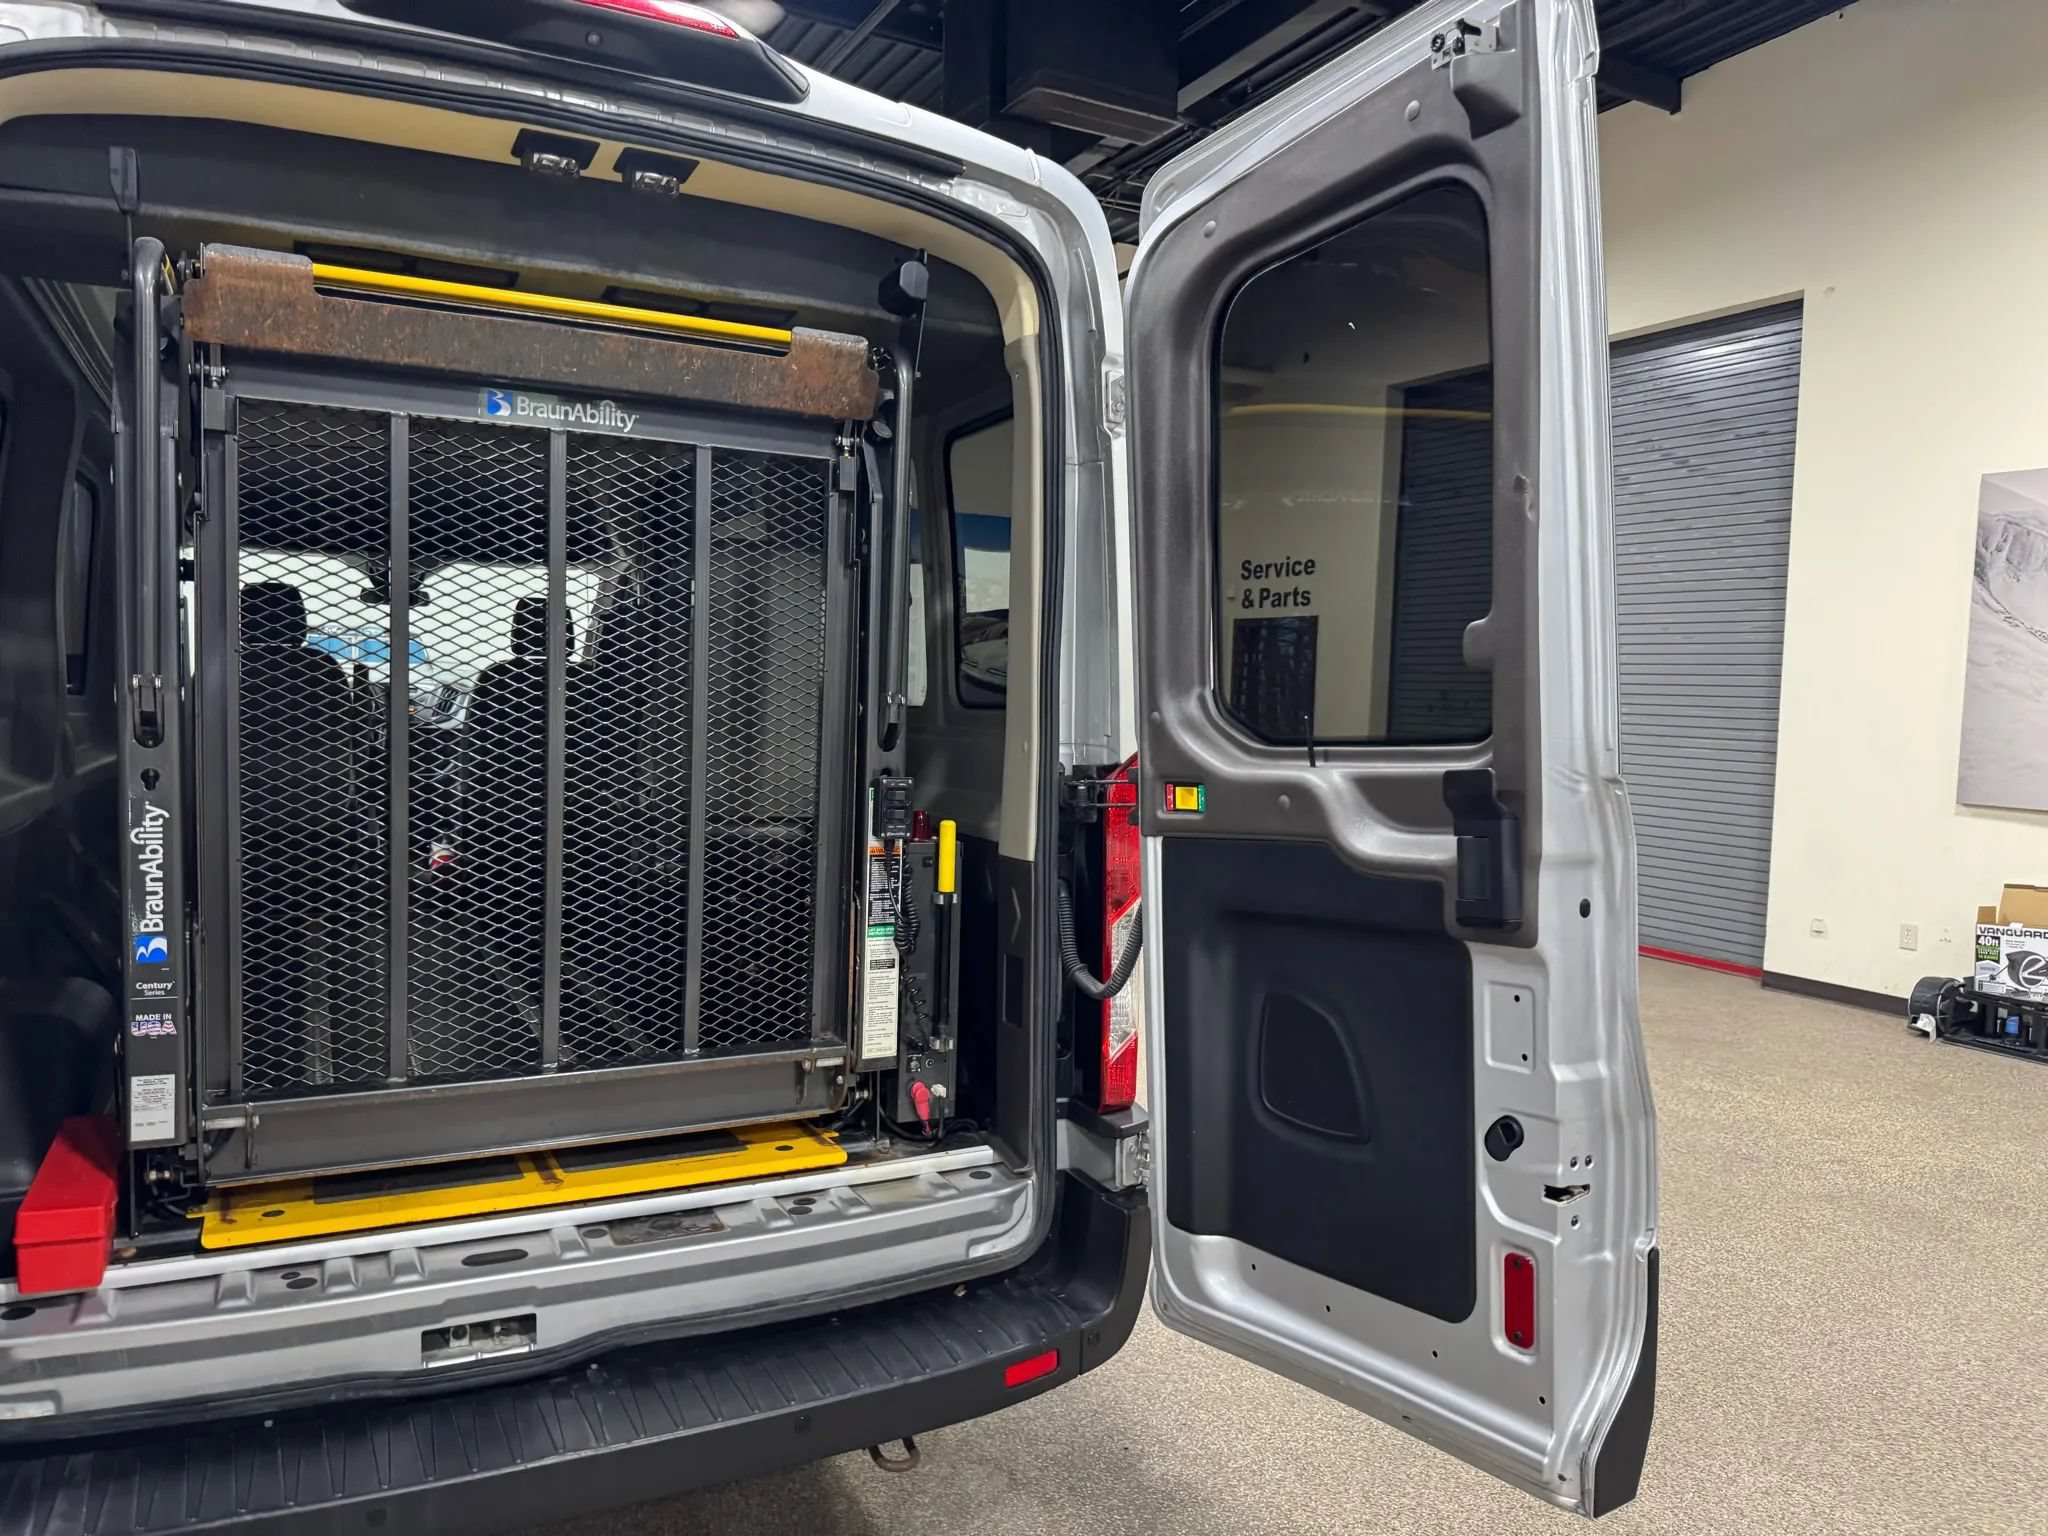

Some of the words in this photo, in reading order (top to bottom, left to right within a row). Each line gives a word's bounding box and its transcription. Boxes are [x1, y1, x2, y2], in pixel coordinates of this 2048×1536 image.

[516, 396, 638, 432] BraunAbility
[1241, 556, 1316, 580] Service
[1241, 588, 1254, 609] &
[1258, 586, 1311, 609] Parts
[130, 803, 170, 933] BraunAbility
[1979, 926, 2048, 939] VANGUARD
[136, 981, 173, 990] Century
[131, 1021, 177, 1037] USA
